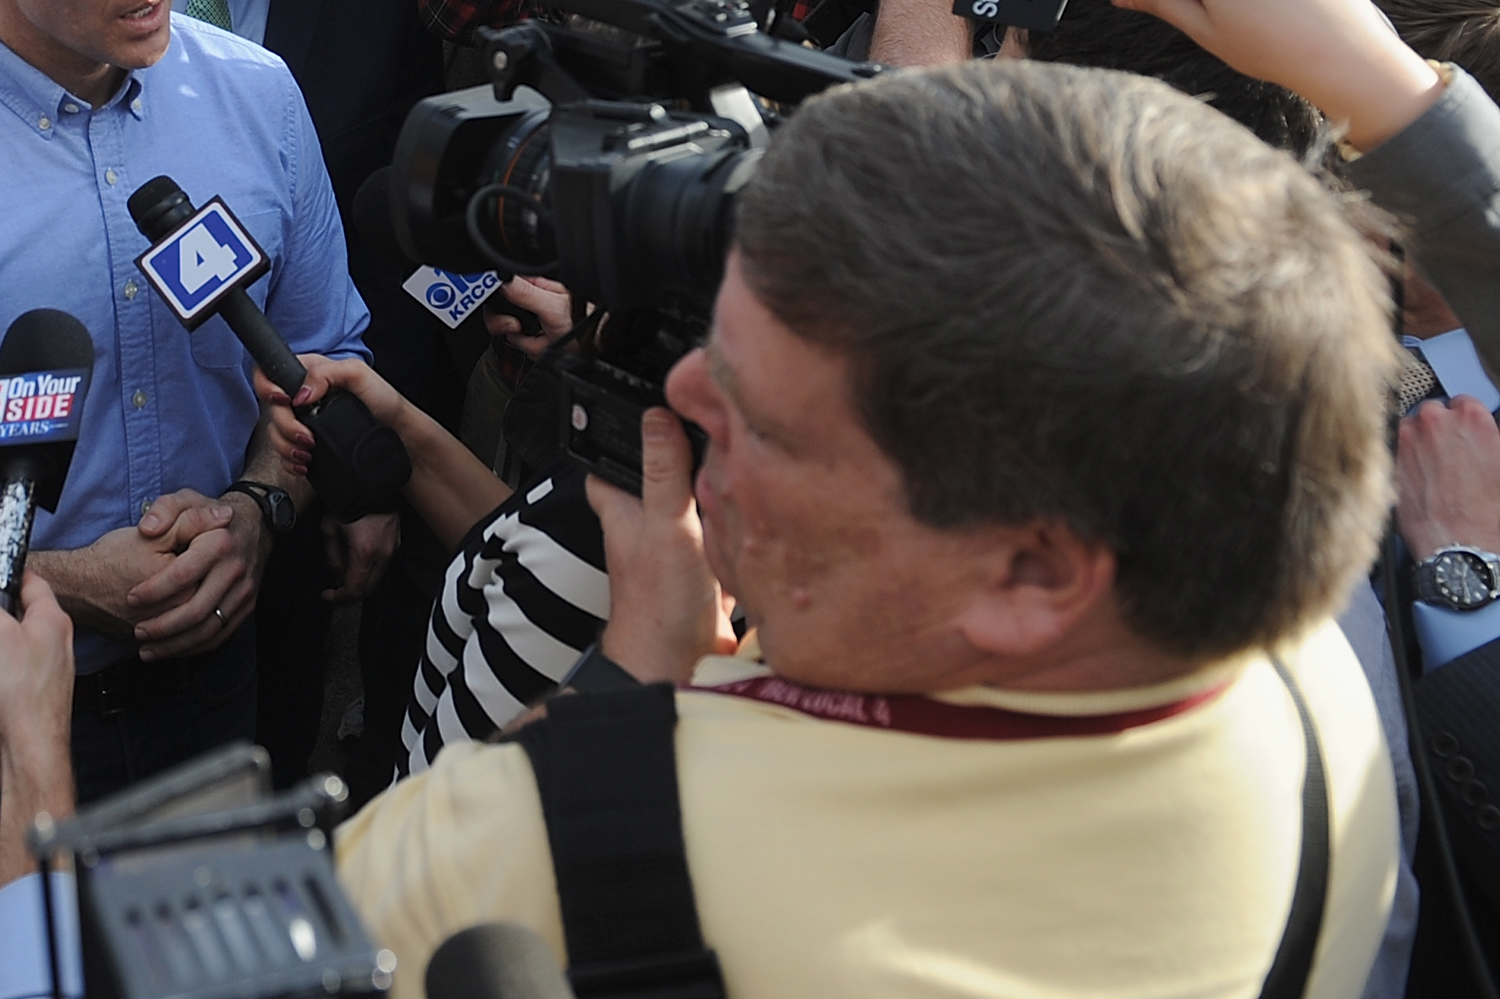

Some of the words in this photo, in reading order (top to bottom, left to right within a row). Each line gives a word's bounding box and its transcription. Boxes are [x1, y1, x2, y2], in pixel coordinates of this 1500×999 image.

[179, 222, 239, 296] 4
[448, 274, 499, 321] KRCG
[9, 377, 36, 399] On
[37, 374, 81, 395] Your
[5, 393, 71, 422] SIDE
[0, 421, 50, 438] YEARS
